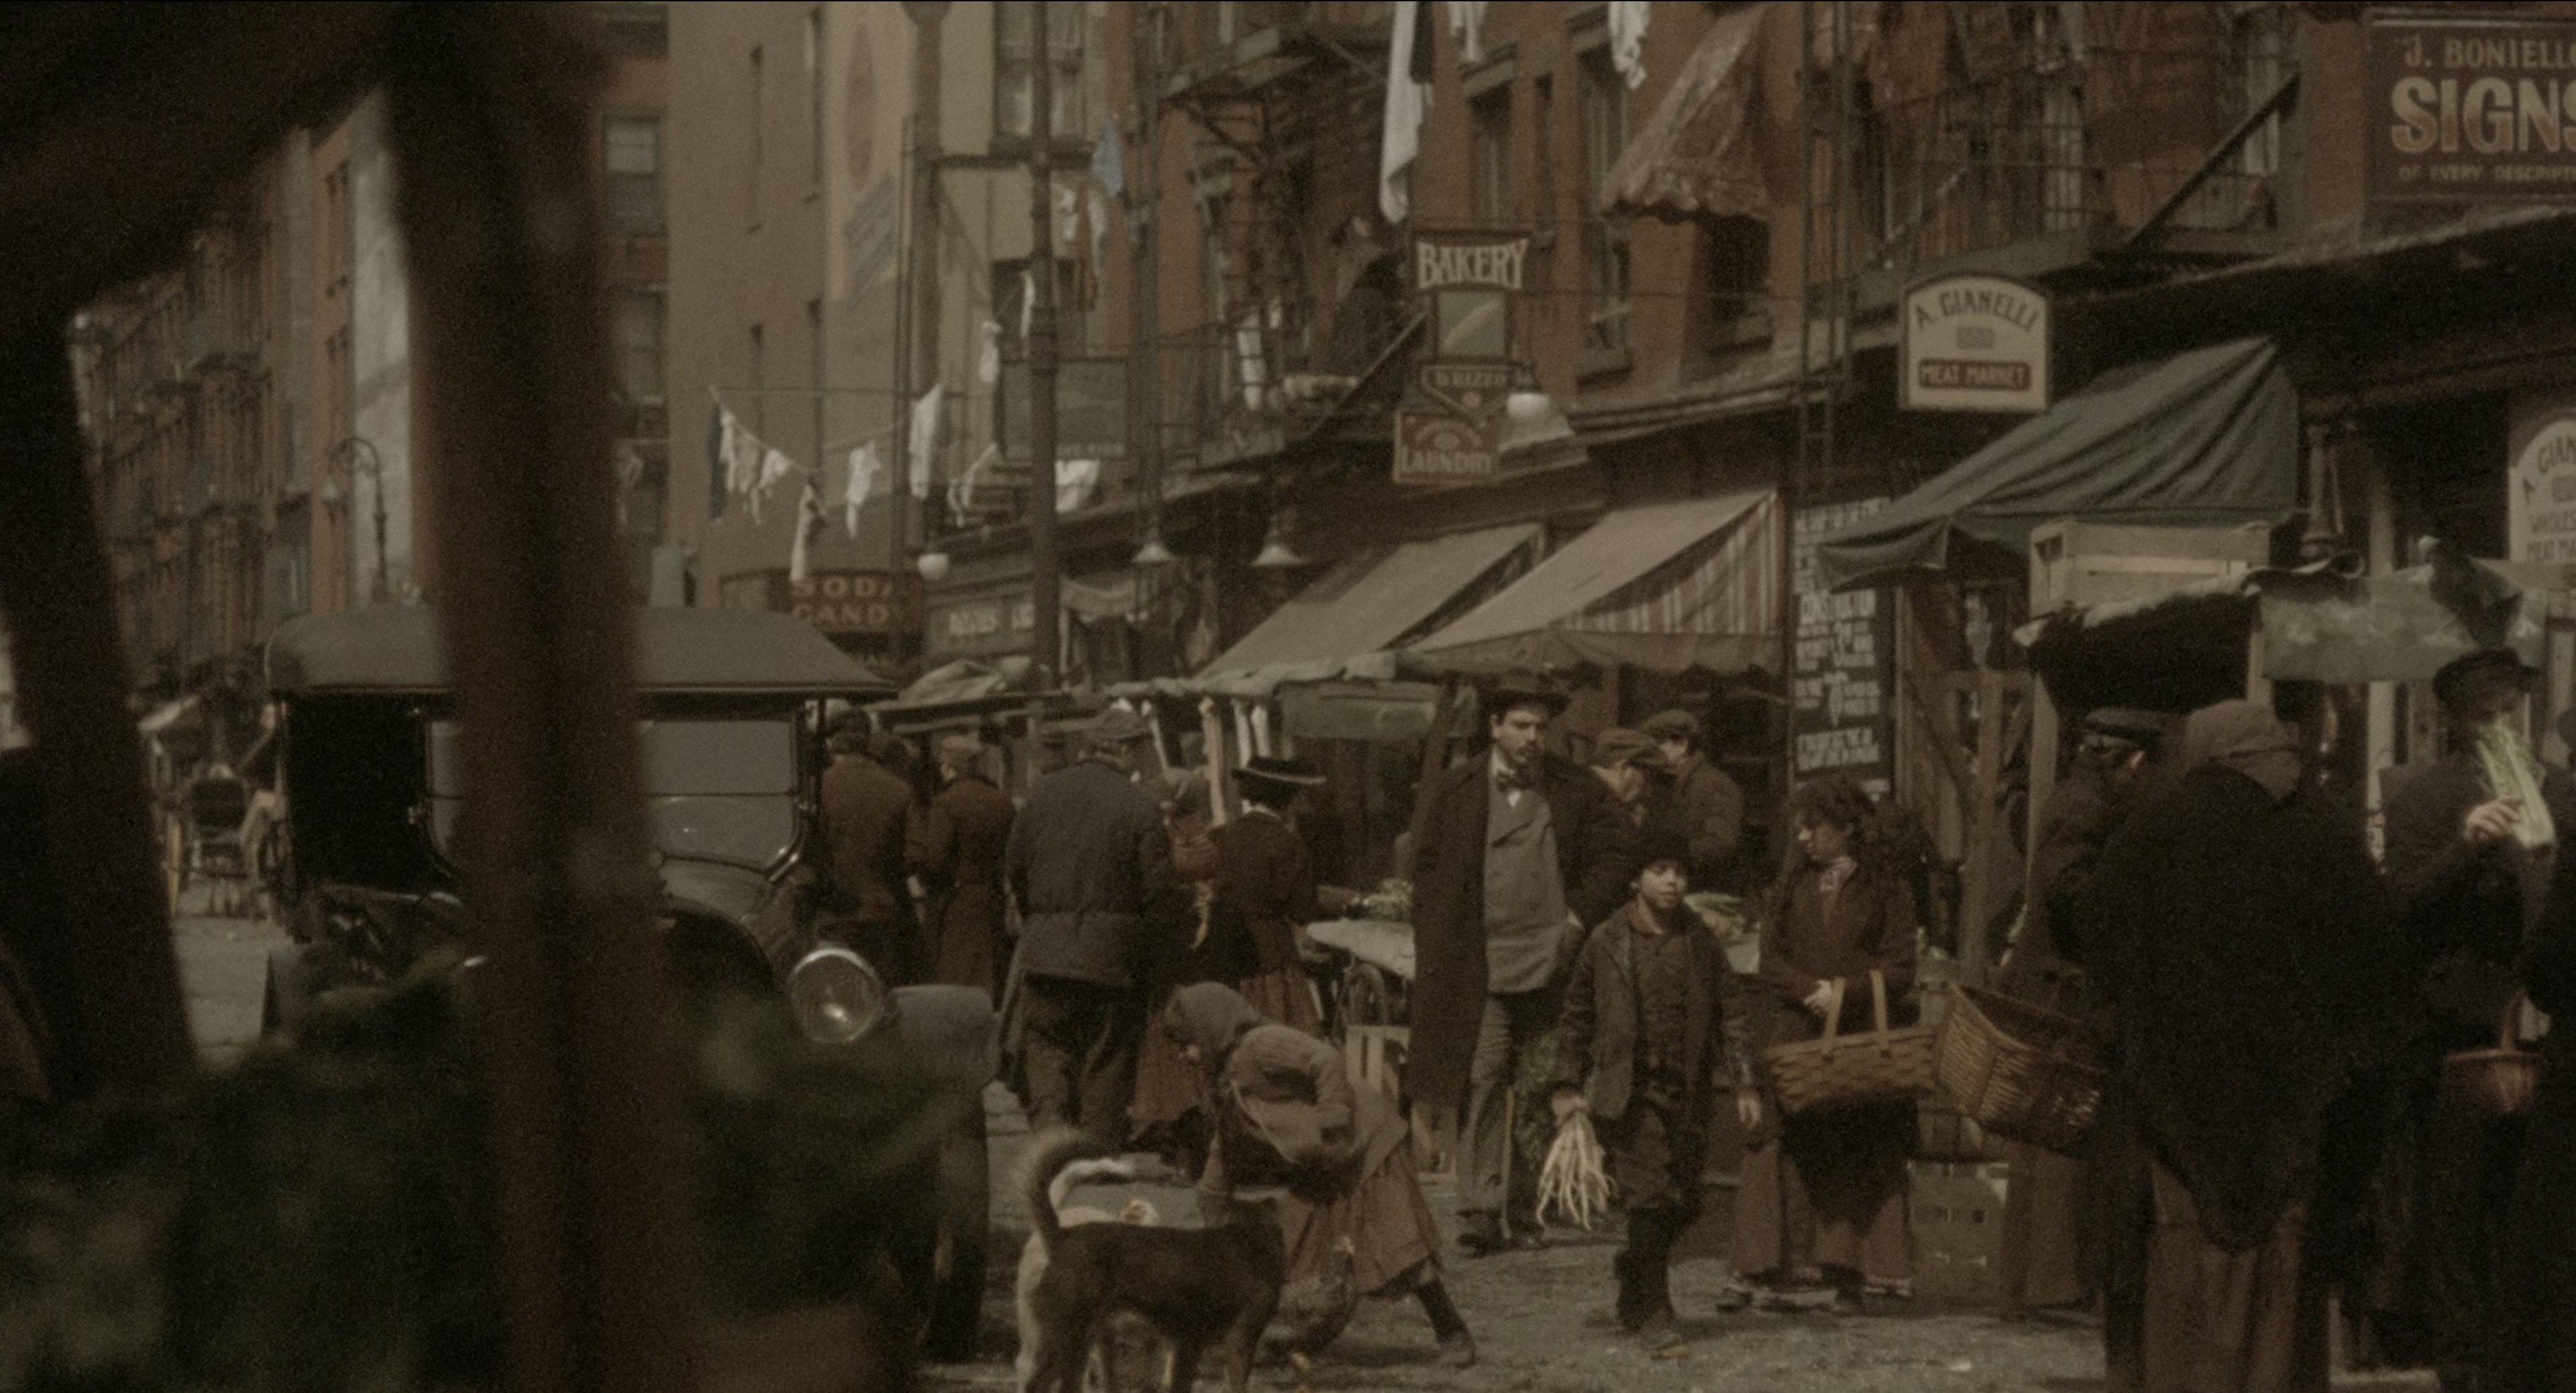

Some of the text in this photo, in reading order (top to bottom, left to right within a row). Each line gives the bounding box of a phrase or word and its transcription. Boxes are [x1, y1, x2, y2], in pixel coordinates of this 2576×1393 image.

[1416, 237, 1529, 291] BAKERY
[1939, 289, 2039, 333] GIANELLI
[1921, 364, 1960, 386] MEAT
